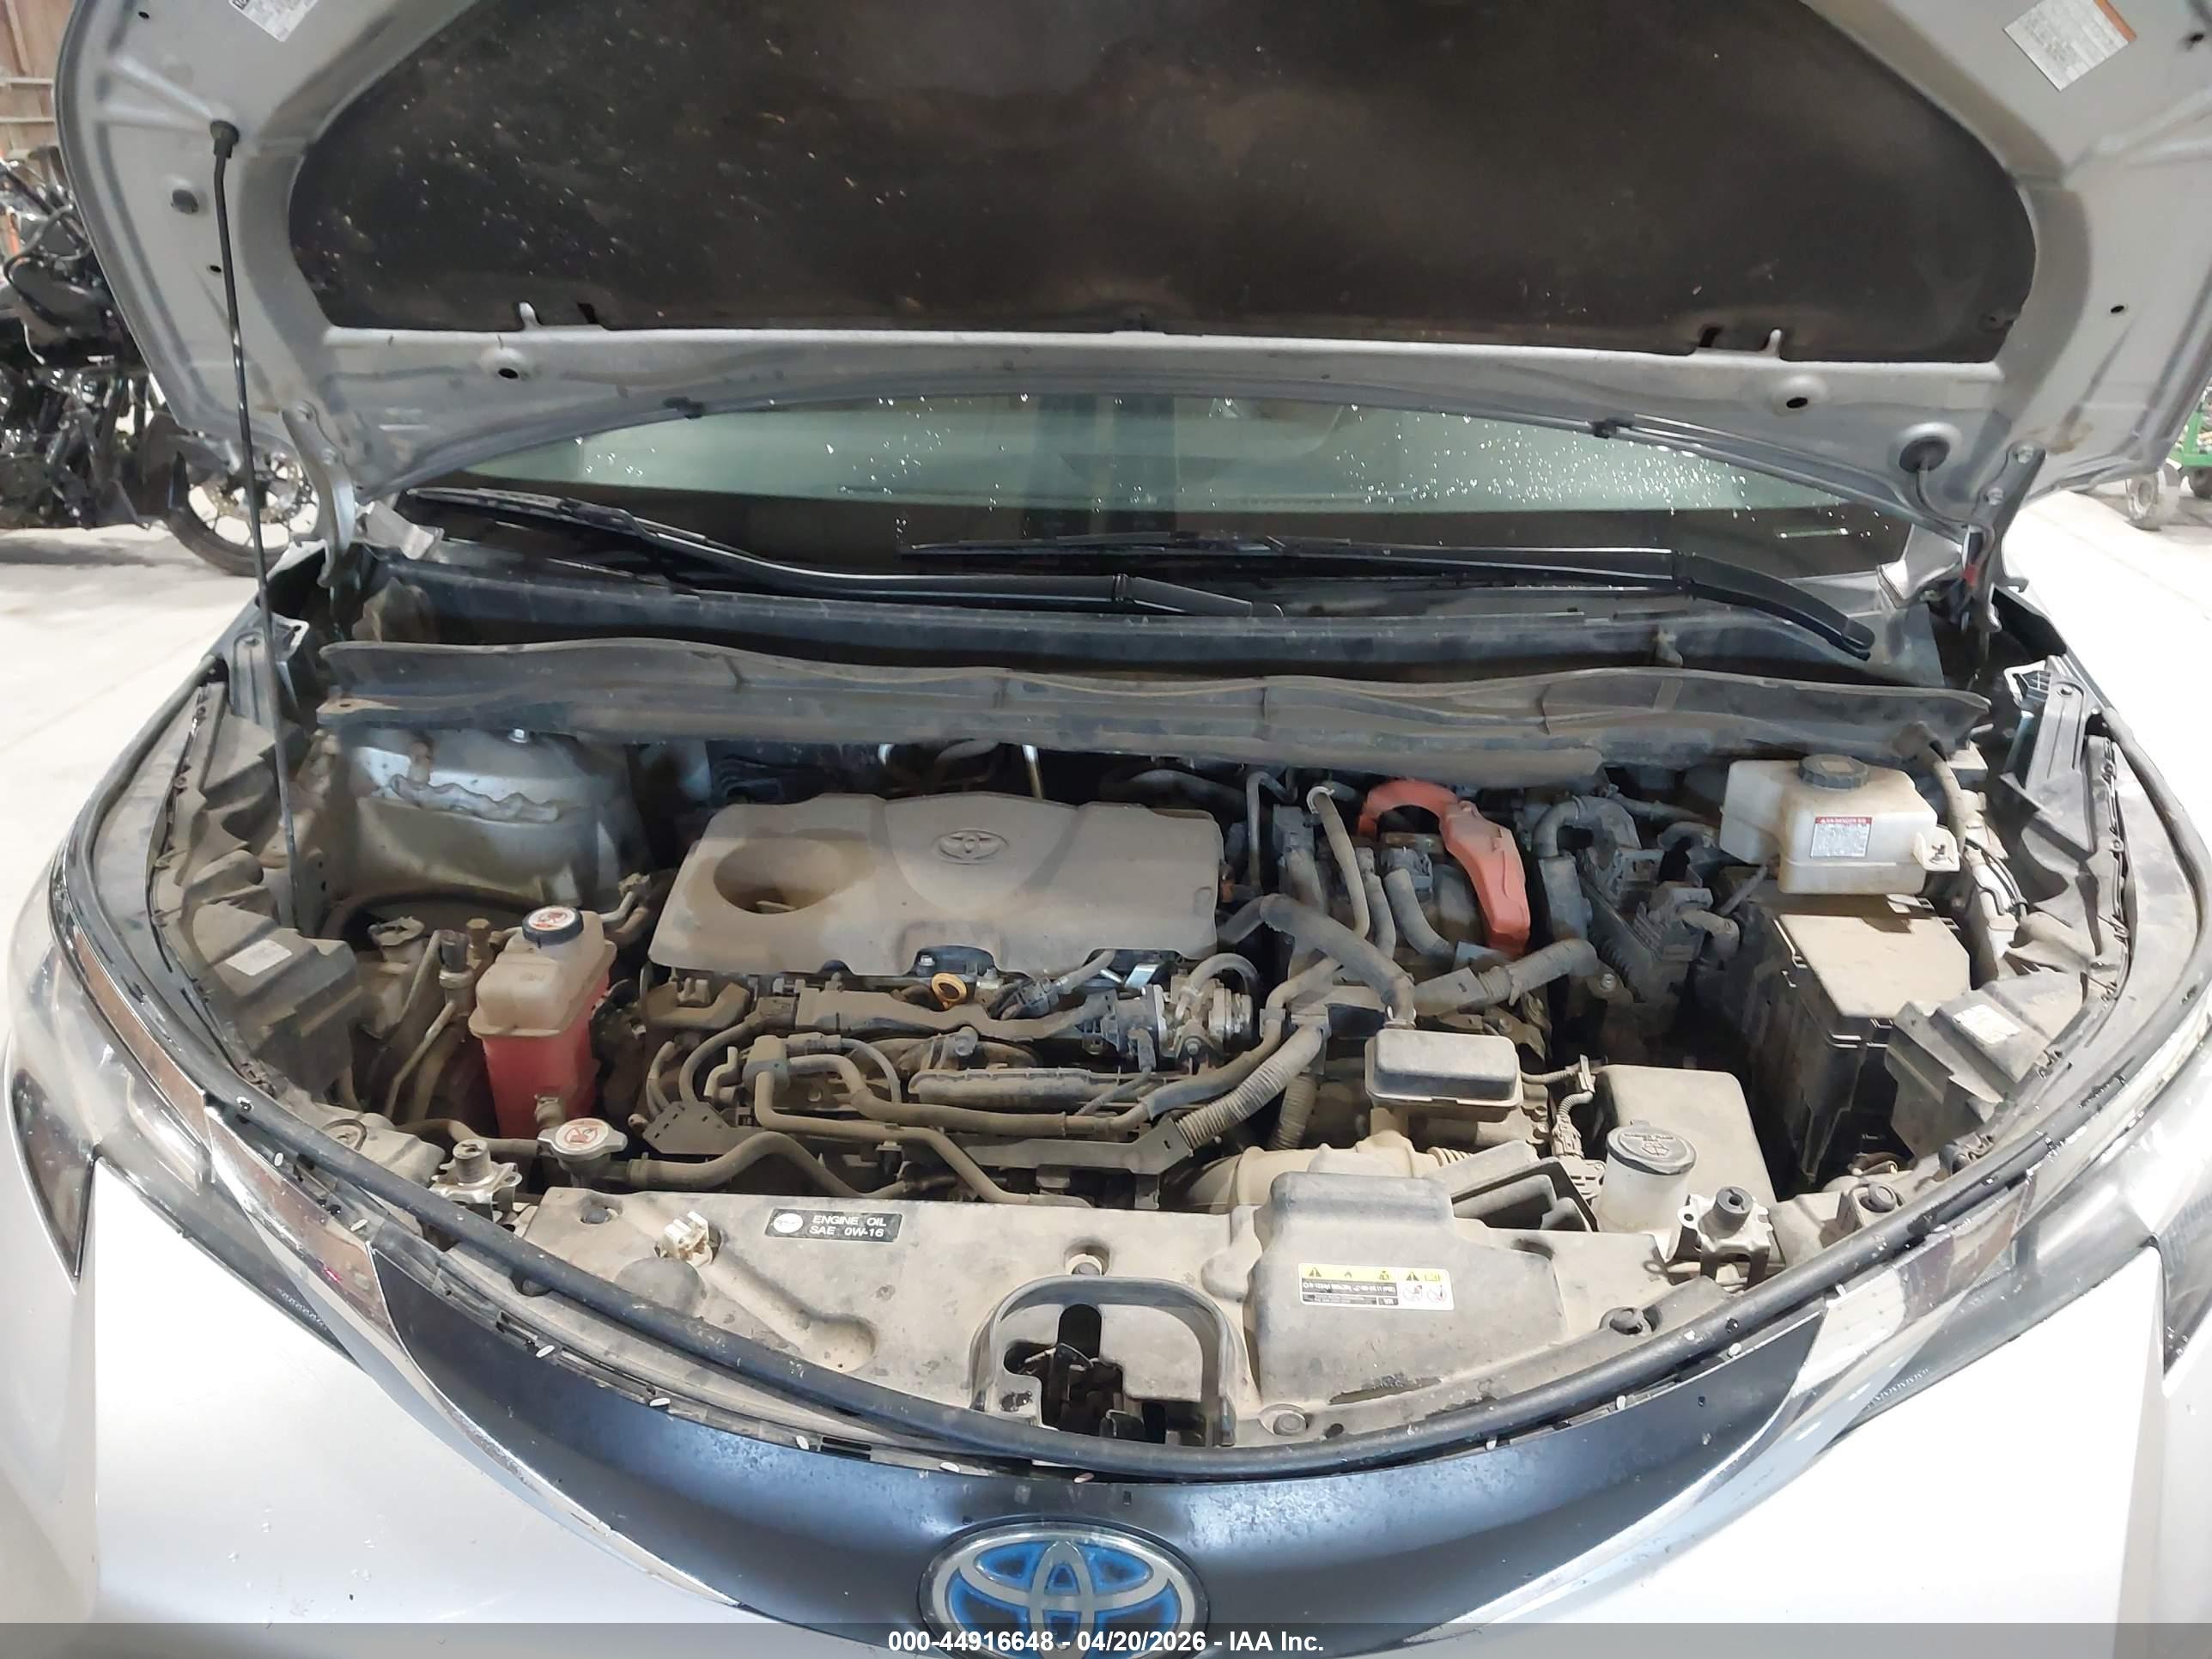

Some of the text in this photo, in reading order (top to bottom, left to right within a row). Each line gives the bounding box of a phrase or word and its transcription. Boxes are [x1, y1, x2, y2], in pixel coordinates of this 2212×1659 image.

[812, 1215, 859, 1225] ENGINE
[866, 1217, 887, 1227] OIL
[809, 1225, 884, 1237] SAE 0W-16
